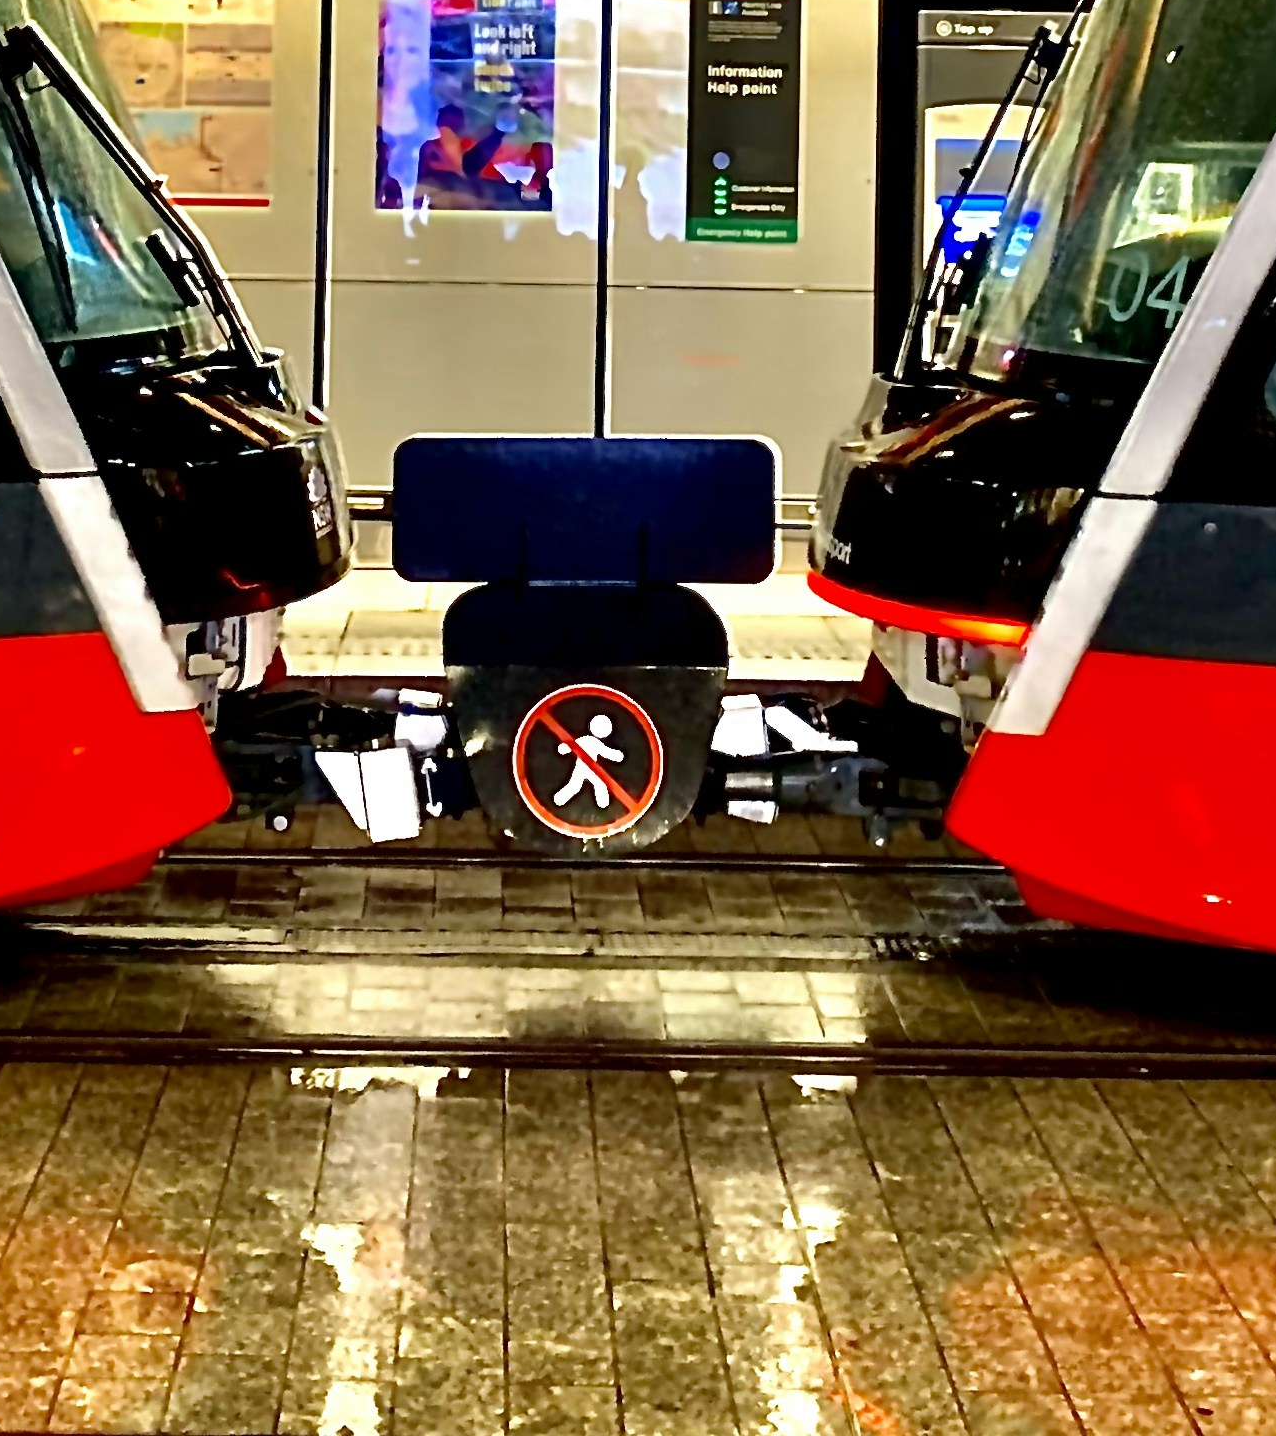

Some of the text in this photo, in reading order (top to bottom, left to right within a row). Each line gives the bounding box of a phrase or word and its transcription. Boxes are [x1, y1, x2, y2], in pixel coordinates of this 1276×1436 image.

[474, 23, 534, 39] Look left
[953, 23, 976, 36] Top
[474, 40, 537, 59] and right
[707, 64, 783, 79] Information
[707, 81, 778, 97] Help point
